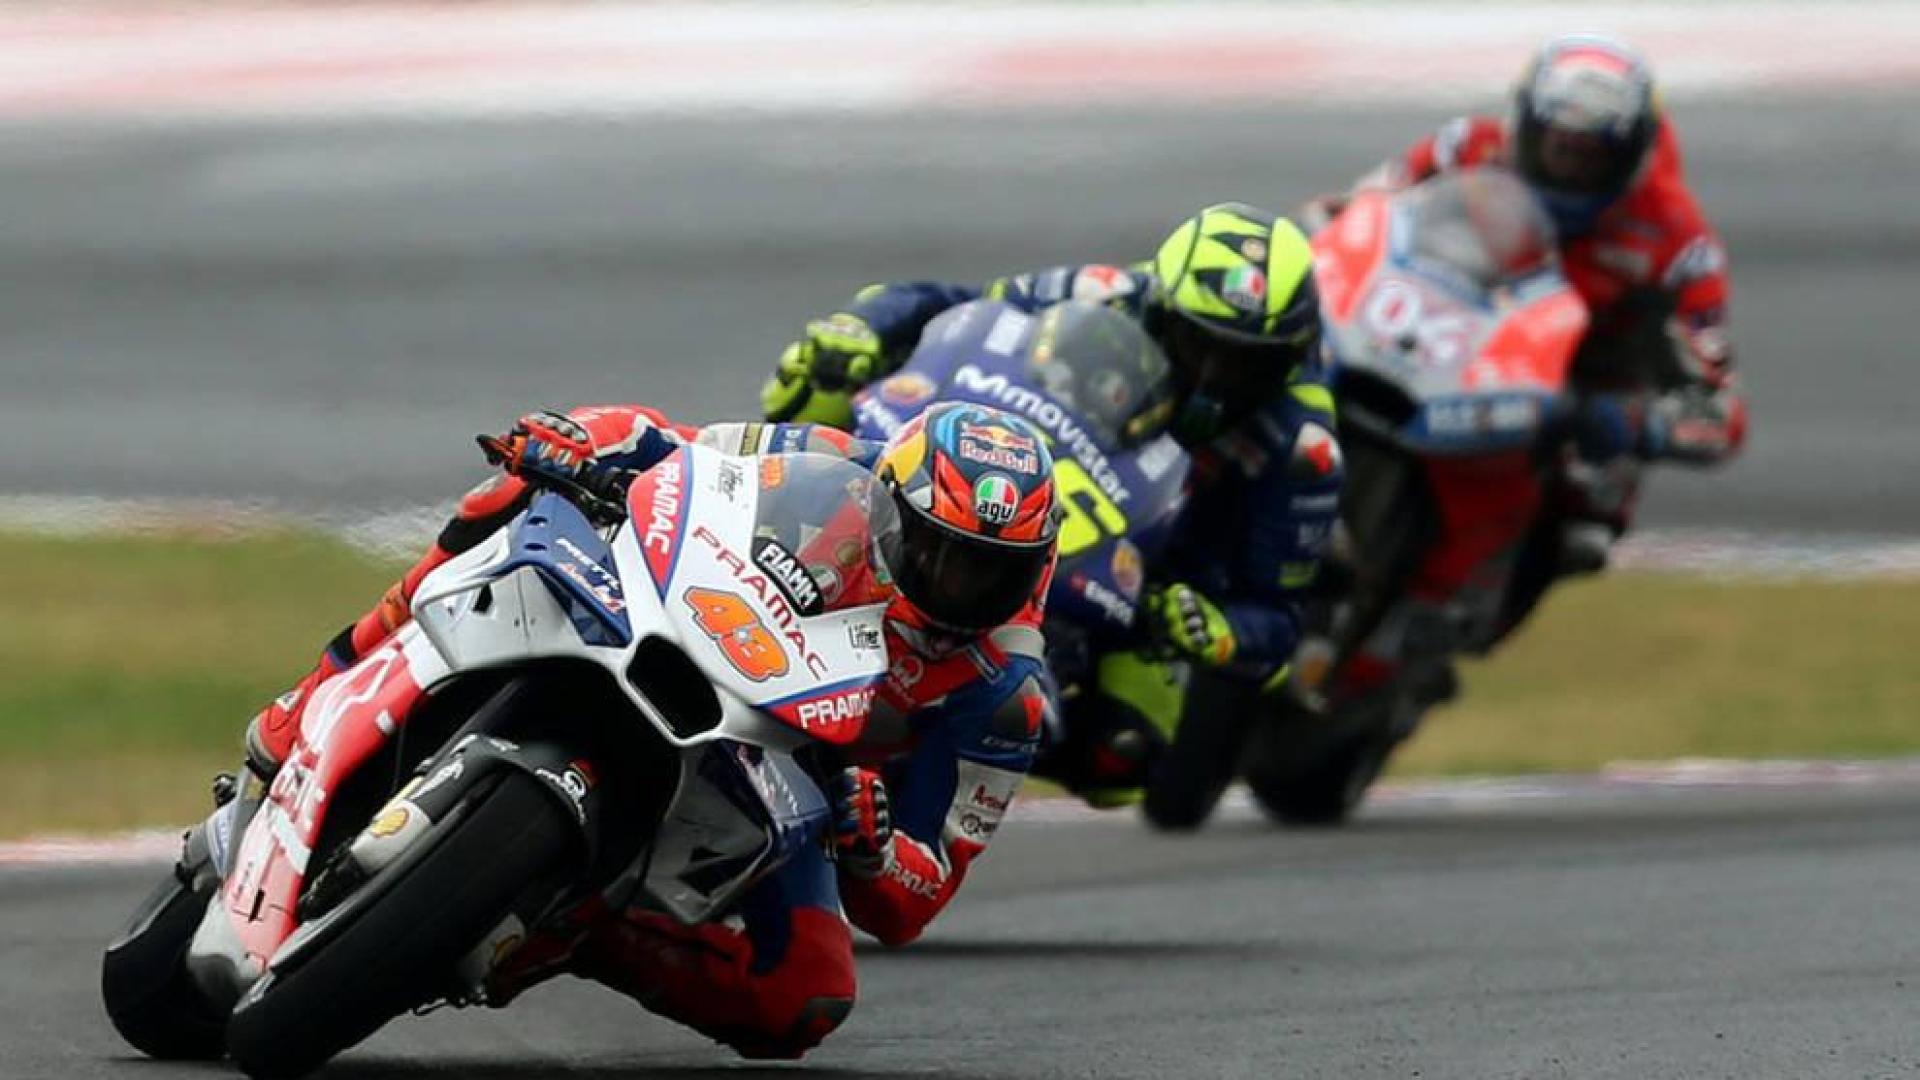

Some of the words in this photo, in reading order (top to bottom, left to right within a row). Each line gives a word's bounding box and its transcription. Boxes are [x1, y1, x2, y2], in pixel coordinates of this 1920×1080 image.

[693, 526, 829, 681] PRAMAC
[757, 542, 819, 610] FIAMM
[683, 585, 790, 683] 43
